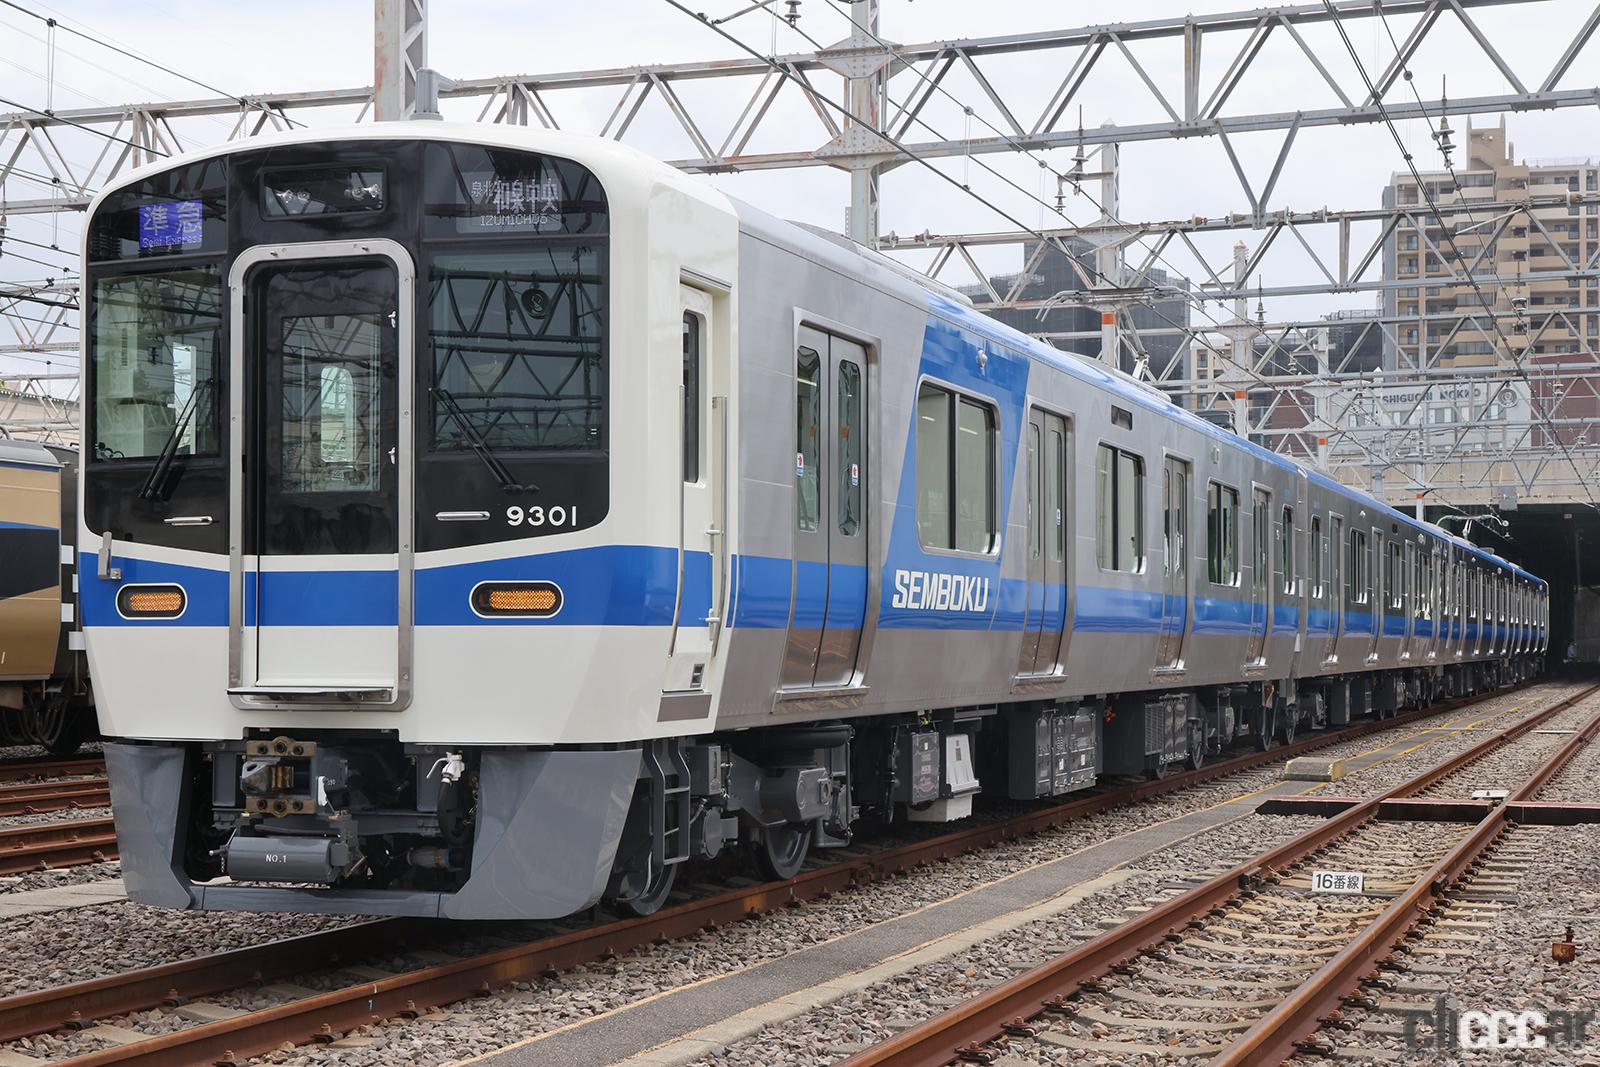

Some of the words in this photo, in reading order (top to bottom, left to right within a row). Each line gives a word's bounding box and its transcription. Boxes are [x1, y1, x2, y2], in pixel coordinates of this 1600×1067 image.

[493, 176, 559, 214] 和泉中央
[143, 201, 201, 236] 準急
[142, 237, 162, 248] Semi
[506, 505, 577, 527] 9301
[892, 569, 989, 612] SEMBOKU
[265, 854, 287, 863] NO.1
[1315, 873, 1360, 890] 16番線
